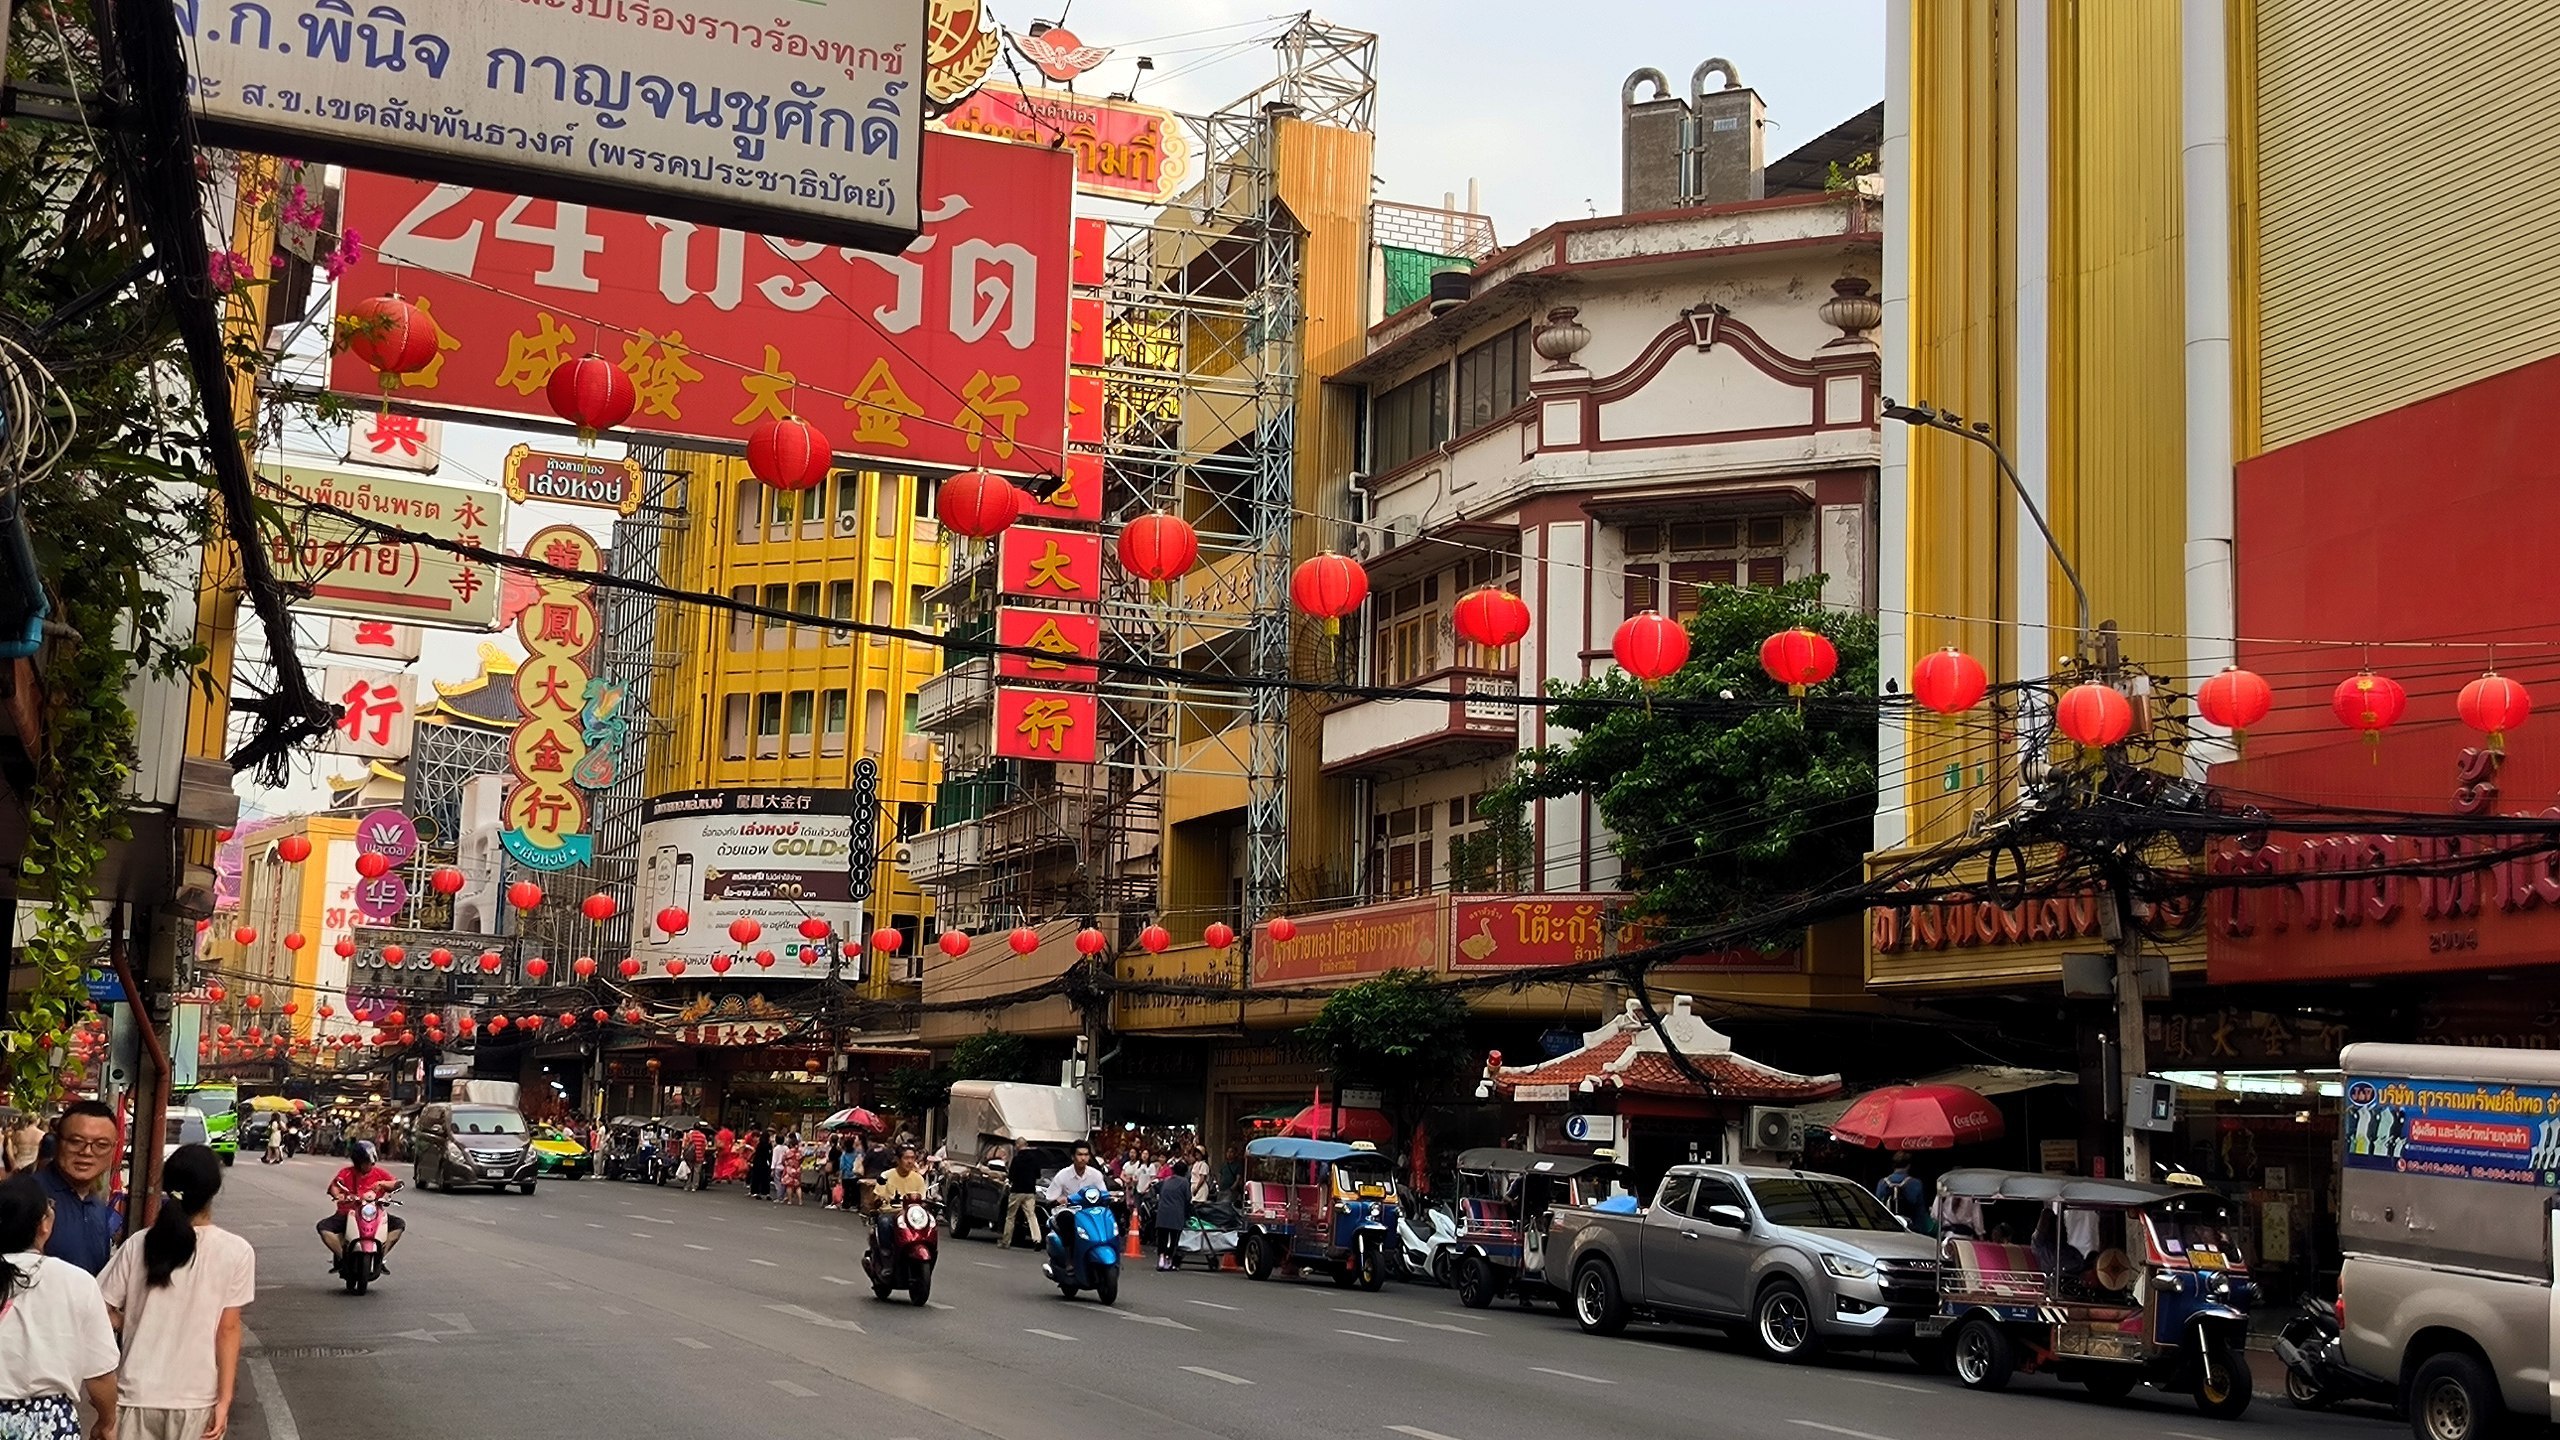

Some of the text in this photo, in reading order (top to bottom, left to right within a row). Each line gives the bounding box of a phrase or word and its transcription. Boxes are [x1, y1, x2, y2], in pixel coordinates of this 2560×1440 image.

[486, 48, 909, 162] กาญจนชูศักดิ์
[242, 83, 579, 158] ส.ข.เขตสัมพันธวงศ์
[588, 137, 896, 216] (พรรคประชาธิปัตย์)
[377, 182, 604, 293] 24
[529, 470, 622, 502] เล่งหงษ์
[740, 821, 800, 836] เล่งหงษ์
[856, 763, 872, 895] GOLDSMITH
[772, 839, 848, 857] GOLD+
[2429, 928, 2479, 953] 2004
[2377, 1083, 2415, 1106] บริษัท
